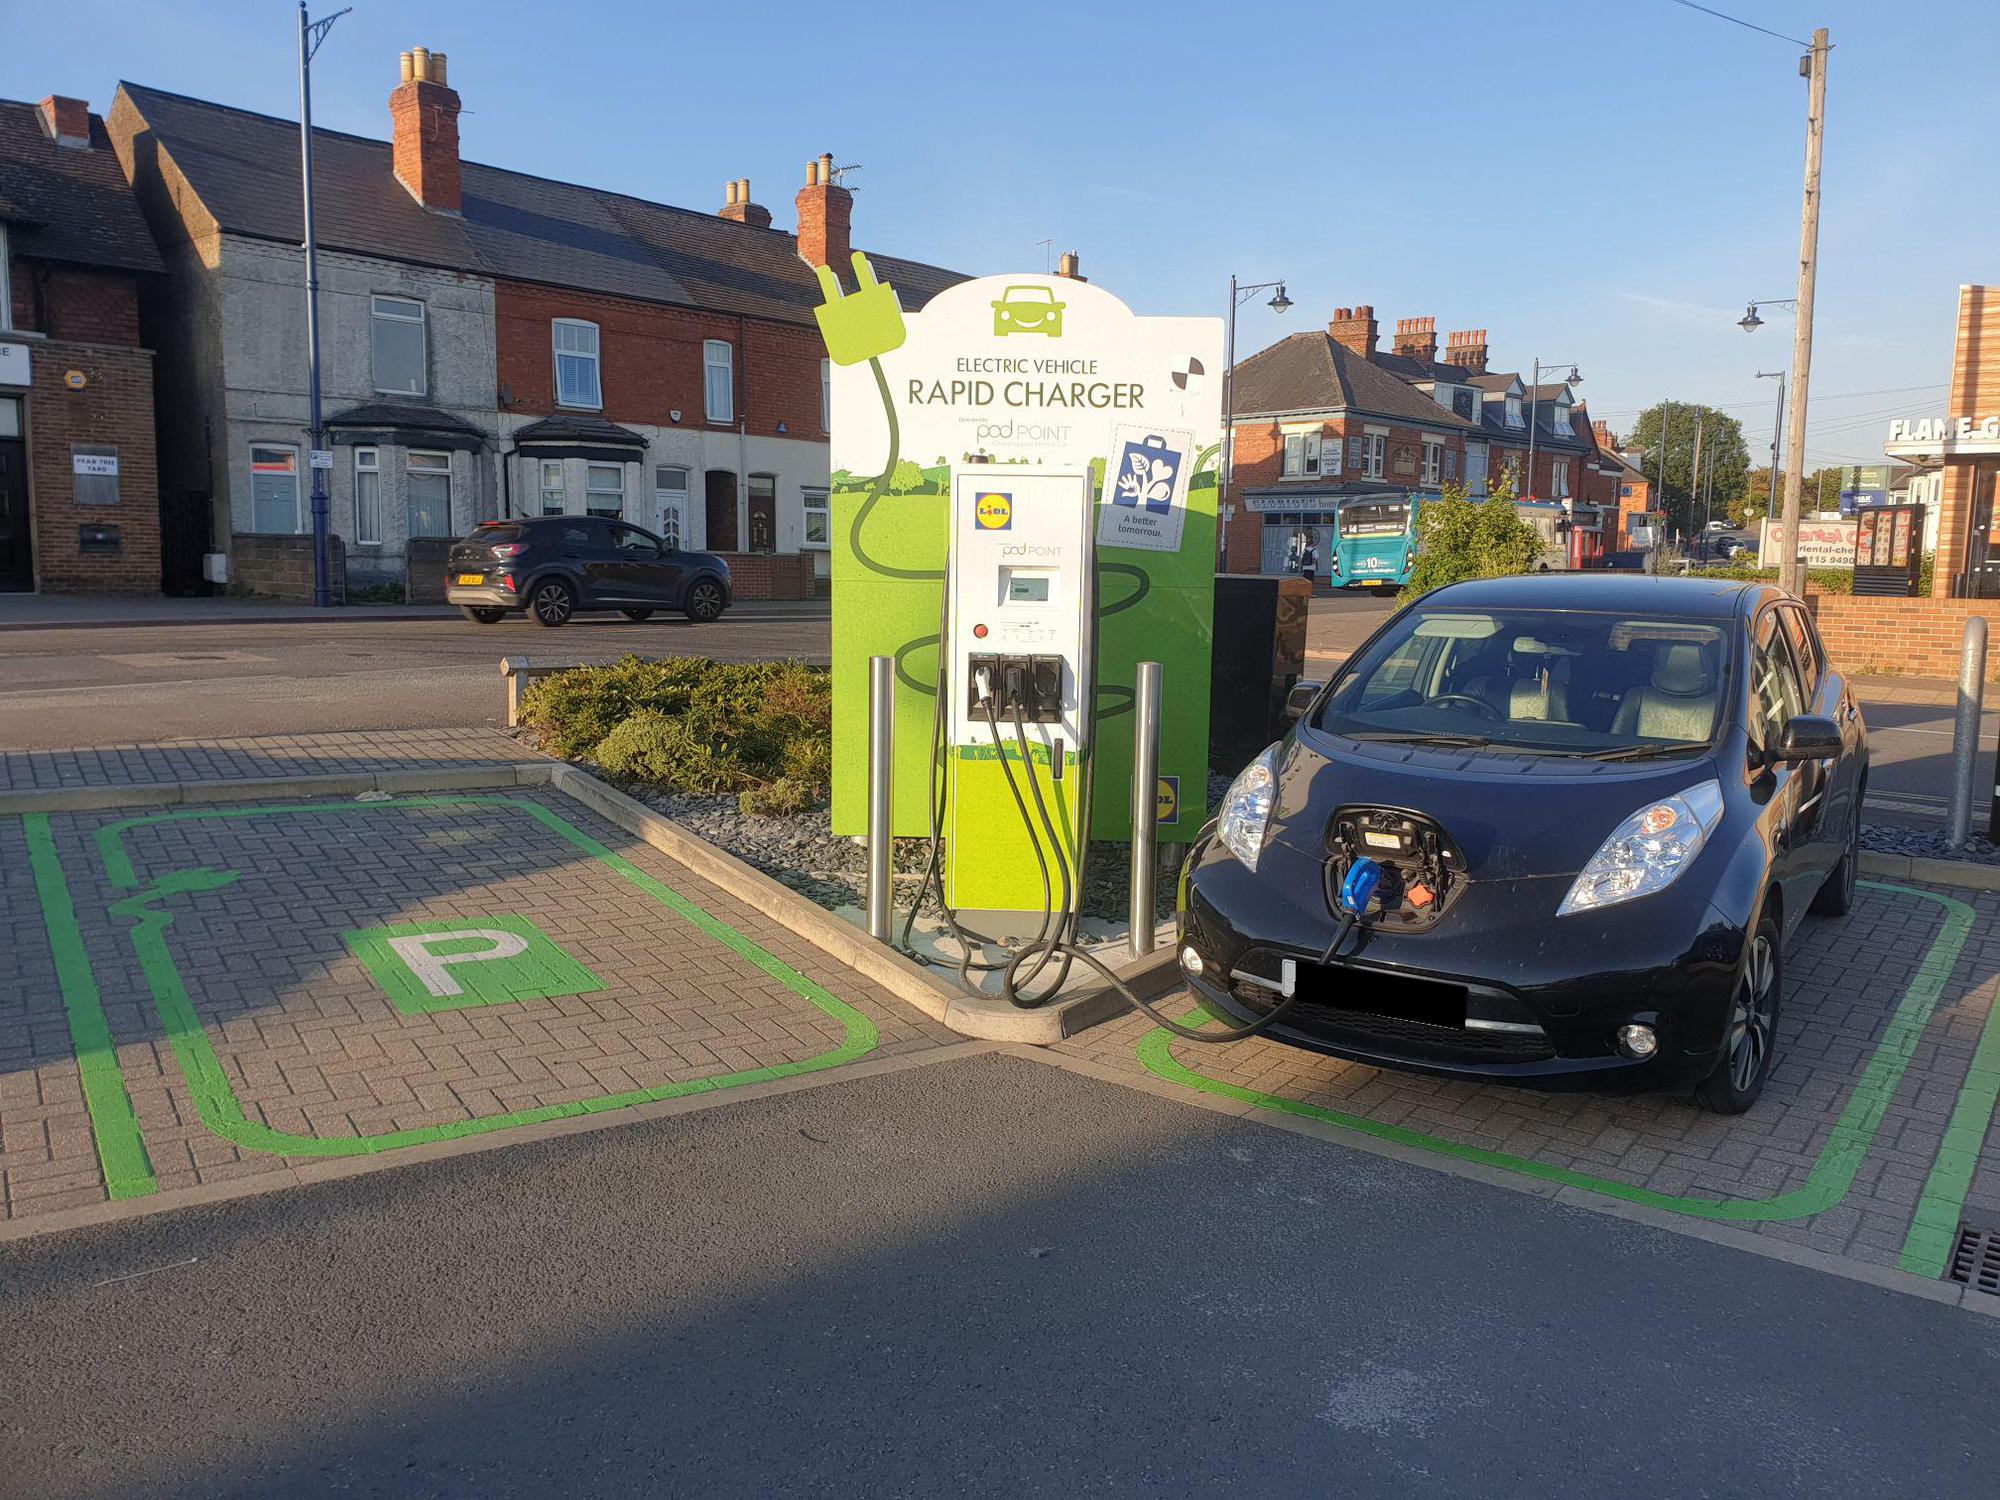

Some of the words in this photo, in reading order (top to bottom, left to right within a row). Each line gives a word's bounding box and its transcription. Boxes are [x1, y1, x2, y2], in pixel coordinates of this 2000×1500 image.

[956, 357, 1029, 374] ELECTRIC
[1034, 359, 1098, 375] VEHICLE
[908, 379, 995, 406] RAPID
[1004, 381, 1145, 409] CHARGER
[976, 417, 1013, 444] pod
[1017, 424, 1073, 440] POINT
[1123, 514, 1130, 522] A
[1132, 515, 1158, 527] better
[1117, 523, 1163, 538] tomorrow.
[1770, 527, 1843, 545] Oental
[1366, 556, 1378, 569] 10
[1807, 555, 1827, 564] 115
[387, 928, 529, 997] P
